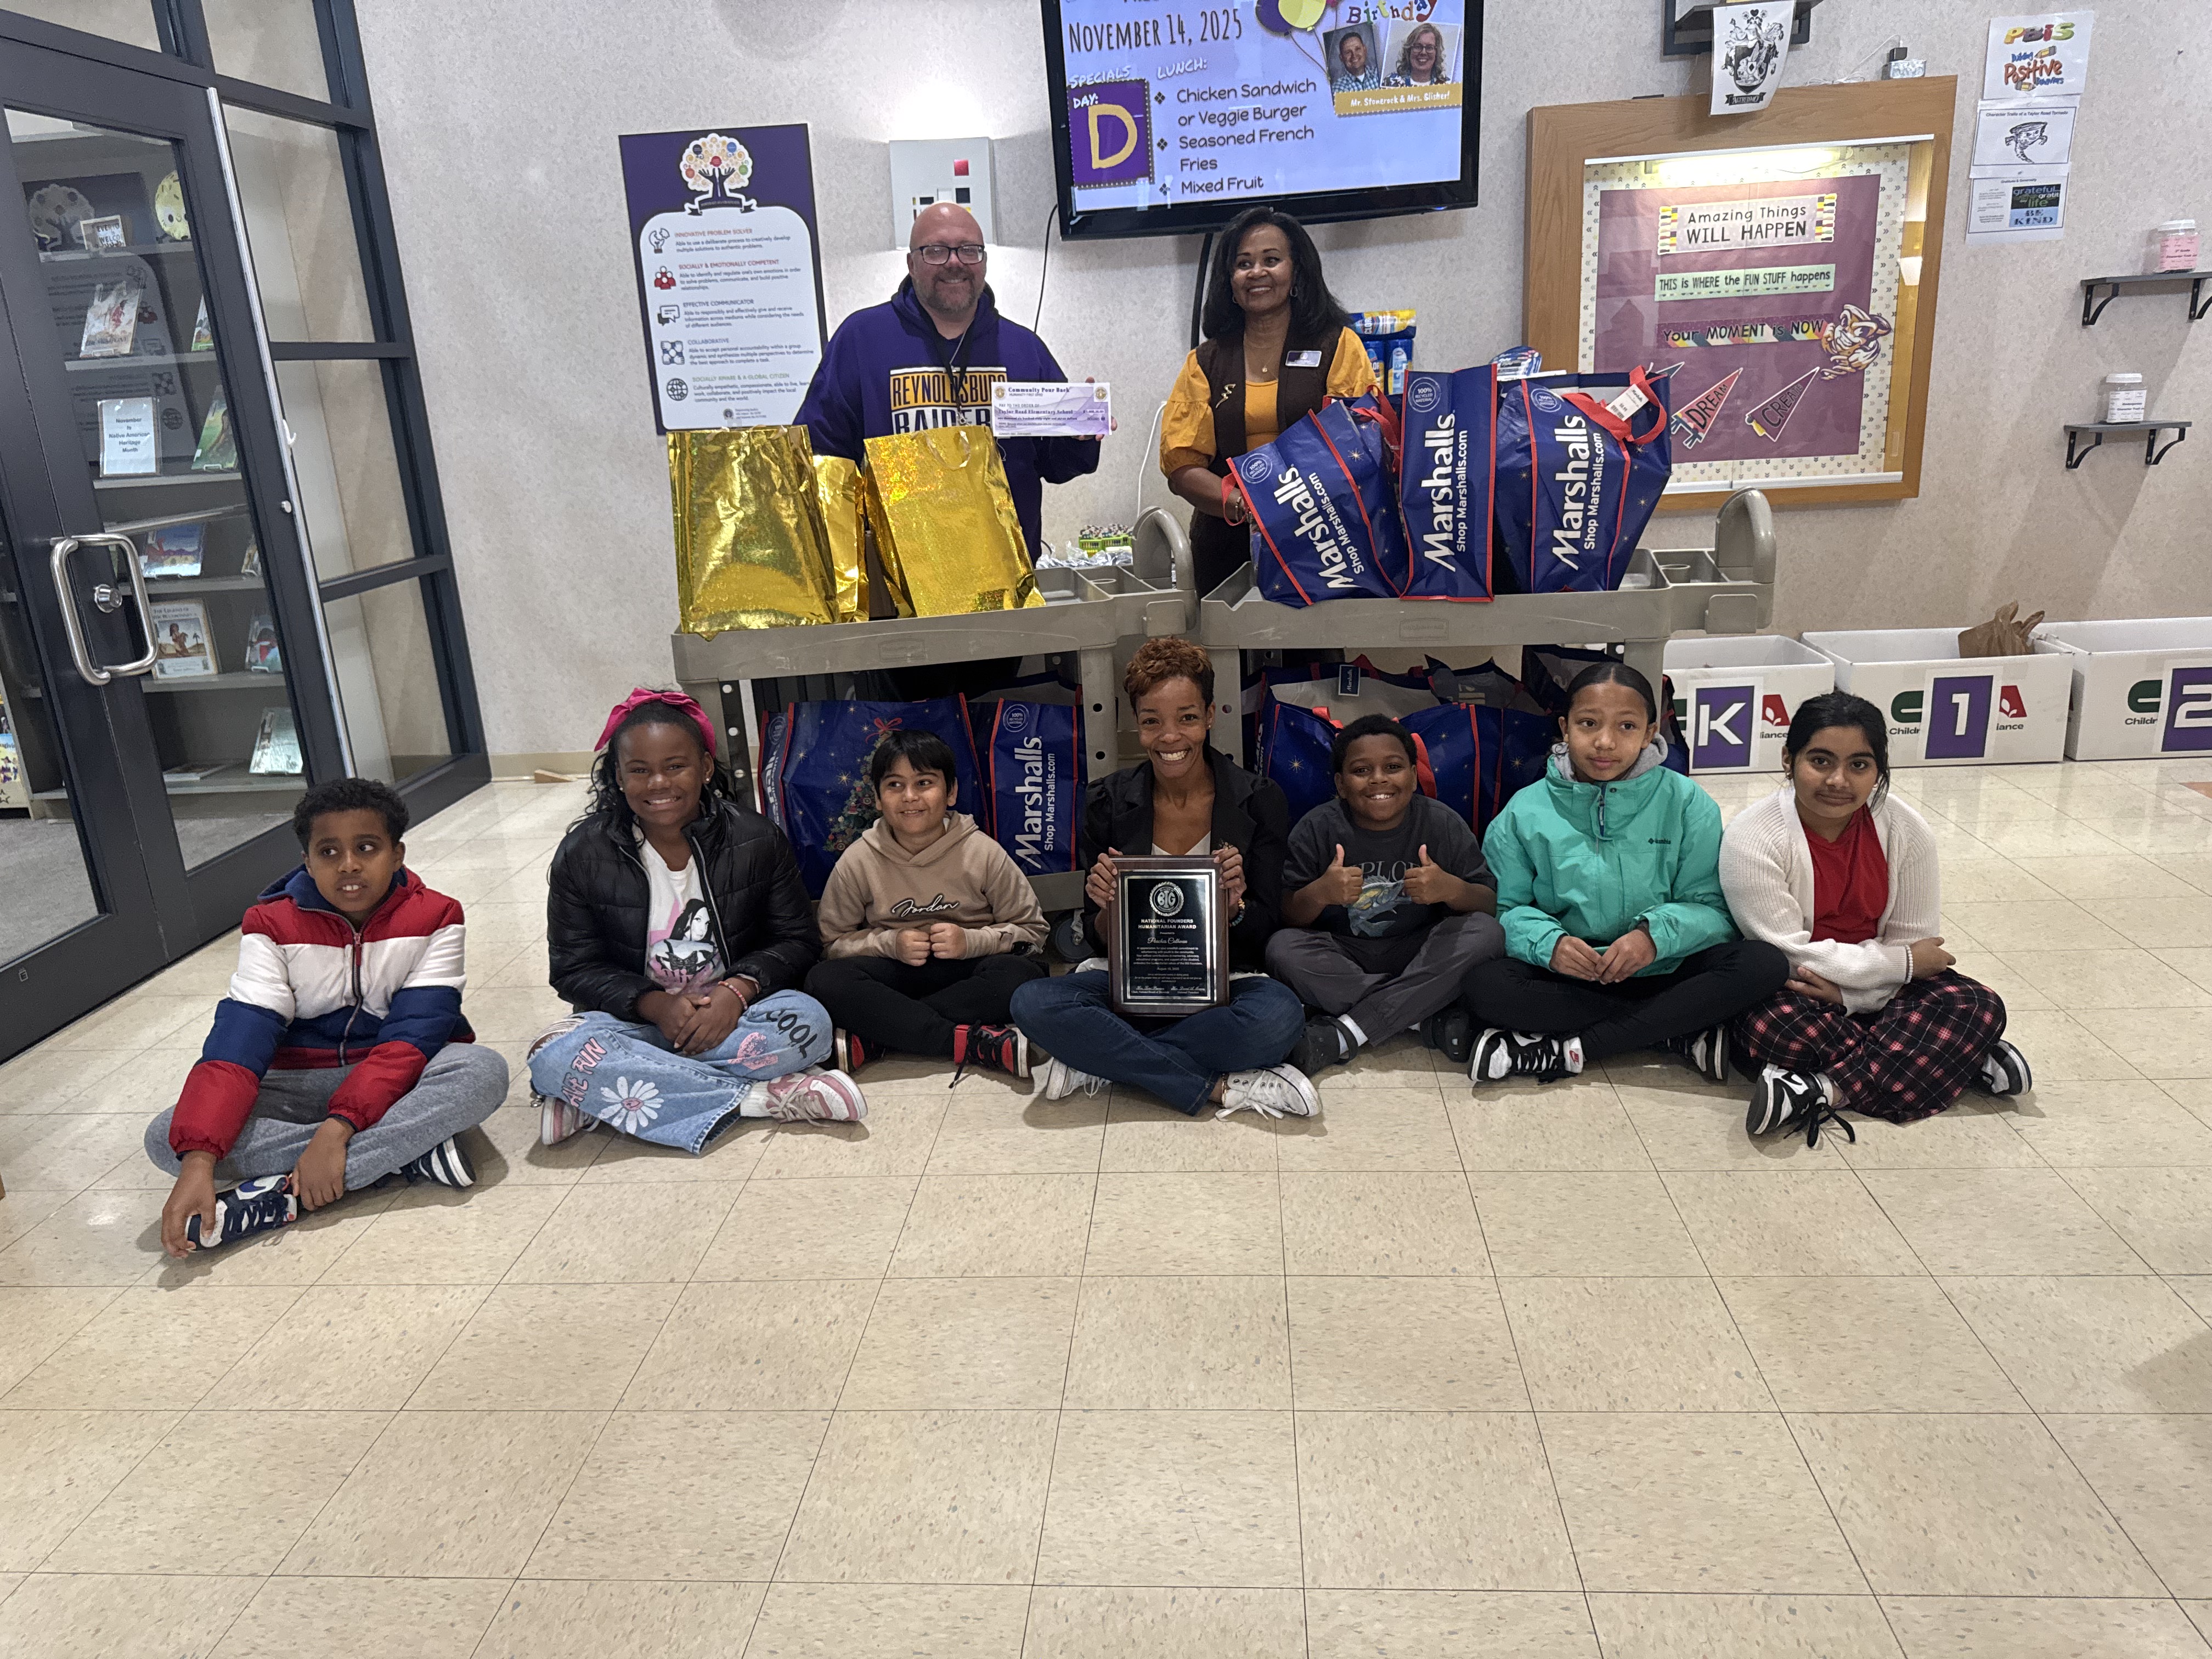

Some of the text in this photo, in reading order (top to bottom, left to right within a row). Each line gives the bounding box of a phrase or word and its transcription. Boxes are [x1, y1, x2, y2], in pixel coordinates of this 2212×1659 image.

[1069, 8, 1242, 53] NOVEMBER 14, 2025
[1070, 65, 1131, 88] SPECIALS
[1157, 57, 1207, 79] LUNCH:
[2004, 59, 2063, 85] Positive
[1073, 93, 1099, 109] DAY:
[1177, 78, 1316, 103] Chicken Sandwich
[1400, 95, 1405, 103] &
[1178, 105, 1307, 127] or Veggie Burger
[1088, 104, 1138, 170] D
[1179, 125, 1314, 149] Seasoned French
[1181, 159, 1218, 171] Fries
[1181, 176, 1263, 194] Mixed Fruit
[1688, 205, 1806, 224] Amazing Things
[2028, 199, 2049, 207] life
[1687, 221, 1806, 244] WILL HAPPEN
[2015, 217, 2053, 225] KIND
[1659, 270, 1830, 290] THIS is WHERE the FUN STUFF happens
[1663, 320, 1824, 343] Your MOMENT is NOW
[1685, 383, 1728, 430] DREAM
[1760, 383, 1803, 428] CREATE
[1249, 459, 1262, 470] 100%
[1421, 414, 1455, 572] Marshalls
[1455, 430, 1468, 552] Shop Marshalls.com
[1553, 415, 1589, 571] Marshalls
[1584, 432, 1604, 549] Shop Marshalls.com
[1274, 467, 1363, 588] Marshalls
[1308, 472, 1364, 574] Shop Marshalls.com
[1952, 693, 1970, 736] 1
[2174, 684, 2212, 728] 2
[1698, 702, 1746, 746] K
[1014, 736, 1042, 868] Marshalls
[1045, 753, 1056, 850] Shop Marshalls.com
[891, 895, 959, 916] Jordan
[1158, 890, 1176, 909] BIG
